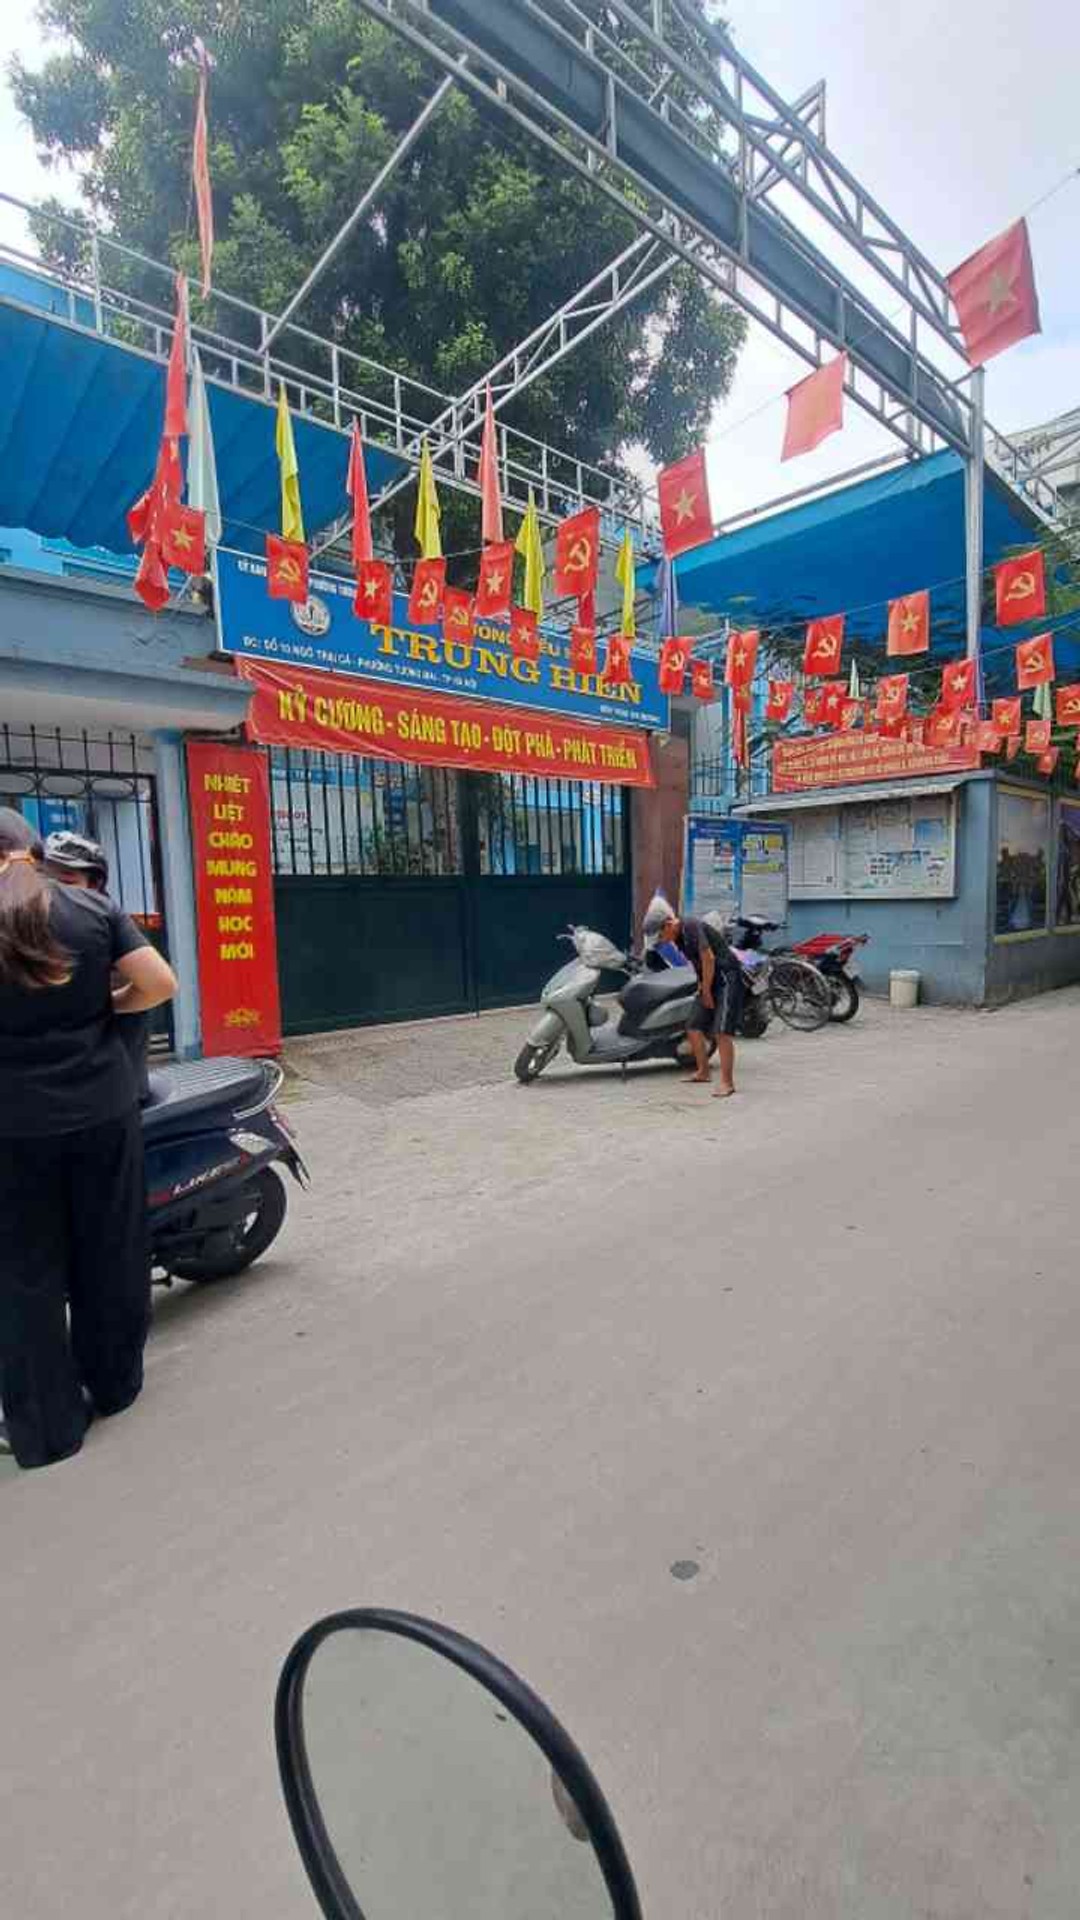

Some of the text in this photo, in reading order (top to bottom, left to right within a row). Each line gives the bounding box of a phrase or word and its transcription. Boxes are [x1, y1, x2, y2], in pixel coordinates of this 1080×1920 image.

[369, 624, 541, 683] TRUNG
[397, 708, 447, 744] SÁNG
[450, 719, 482, 753] TẠO
